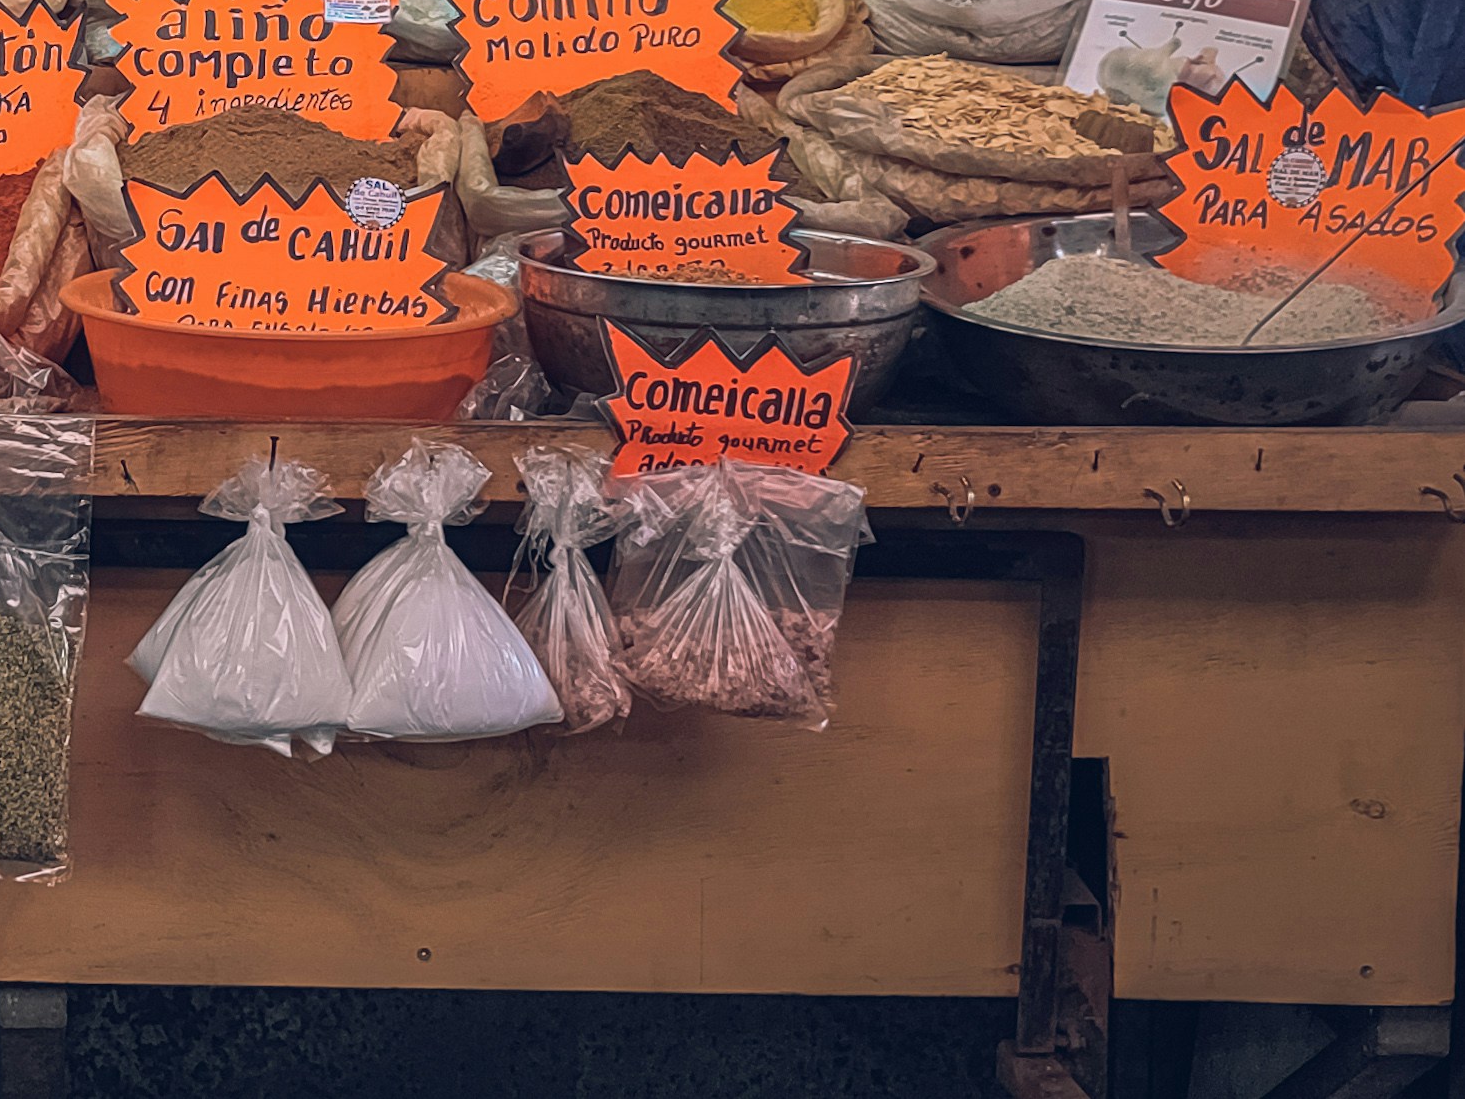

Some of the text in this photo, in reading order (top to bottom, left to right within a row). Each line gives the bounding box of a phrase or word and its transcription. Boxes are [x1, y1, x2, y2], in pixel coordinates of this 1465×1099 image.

[156, 4, 334, 42] aliño
[147, 89, 170, 125] 4
[1192, 105, 1432, 196] SAL de MAR
[366, 180, 389, 190] SAL
[578, 183, 774, 221] Comeicalla
[241, 205, 280, 243] de
[1194, 183, 1268, 229] PARA
[586, 227, 664, 251] Producto
[626, 371, 832, 429] Comeicalla
